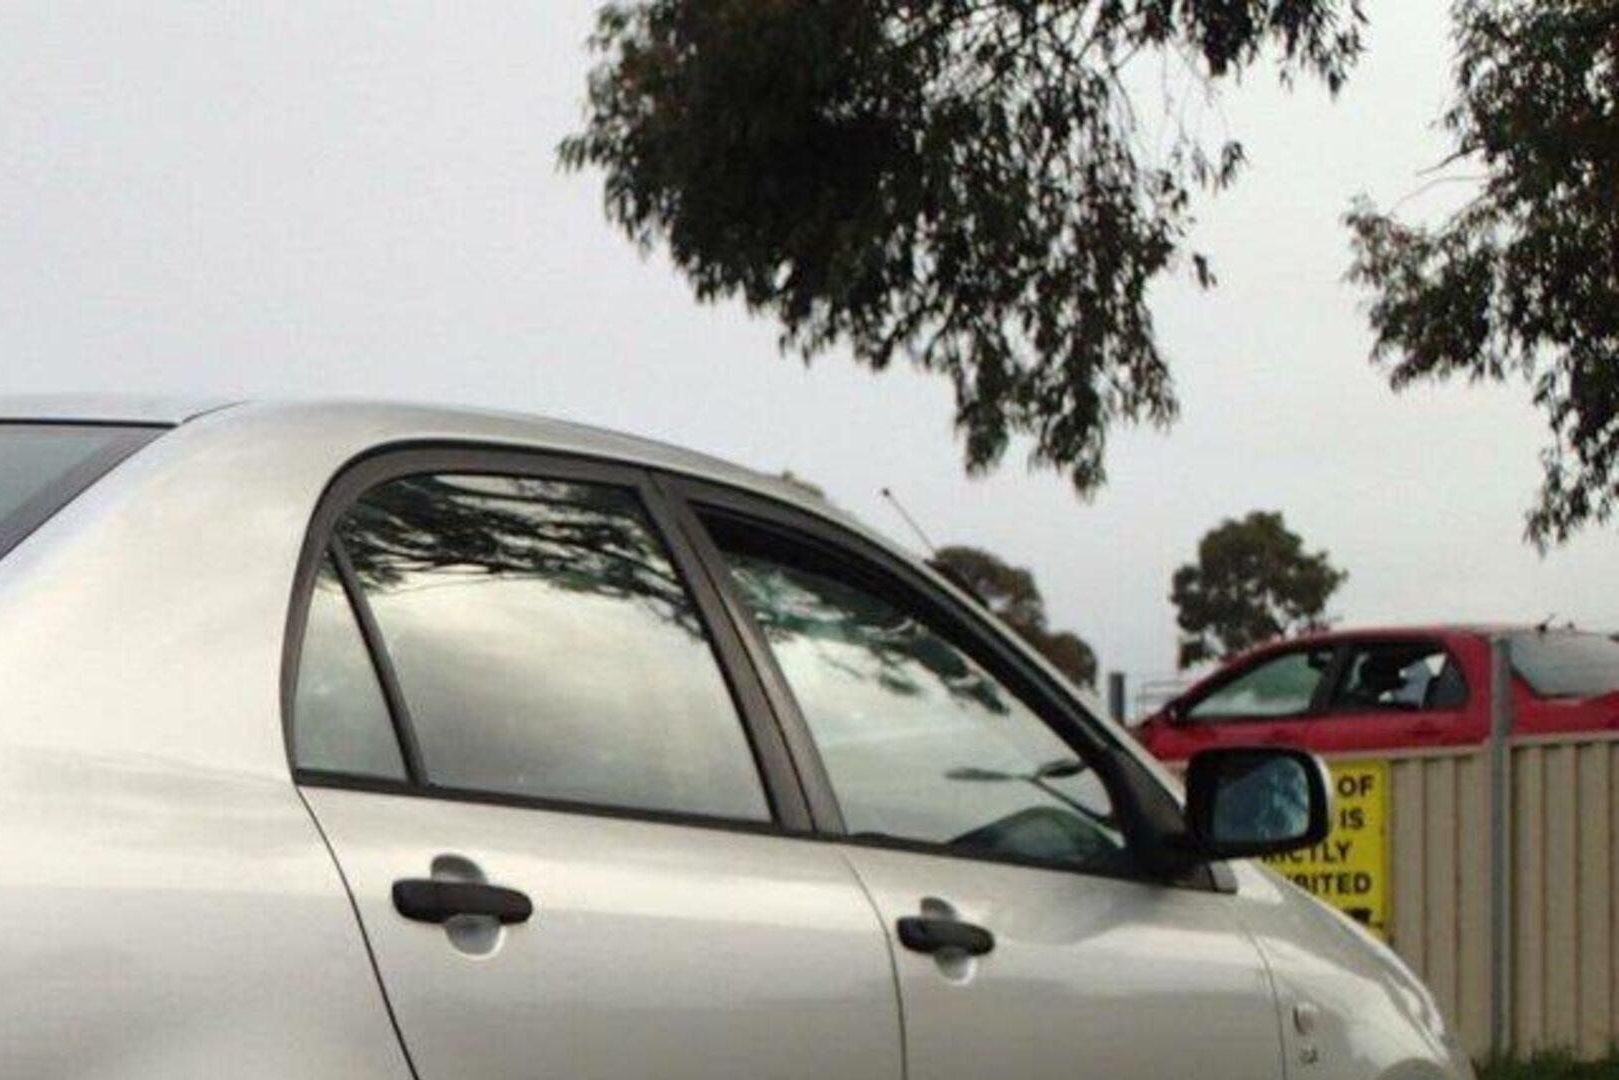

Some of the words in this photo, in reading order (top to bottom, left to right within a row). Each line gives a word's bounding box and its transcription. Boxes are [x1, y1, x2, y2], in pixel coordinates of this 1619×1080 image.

[1337, 775, 1374, 797] OF
[1341, 808, 1364, 830] IS
[1287, 872, 1372, 894] BITED
